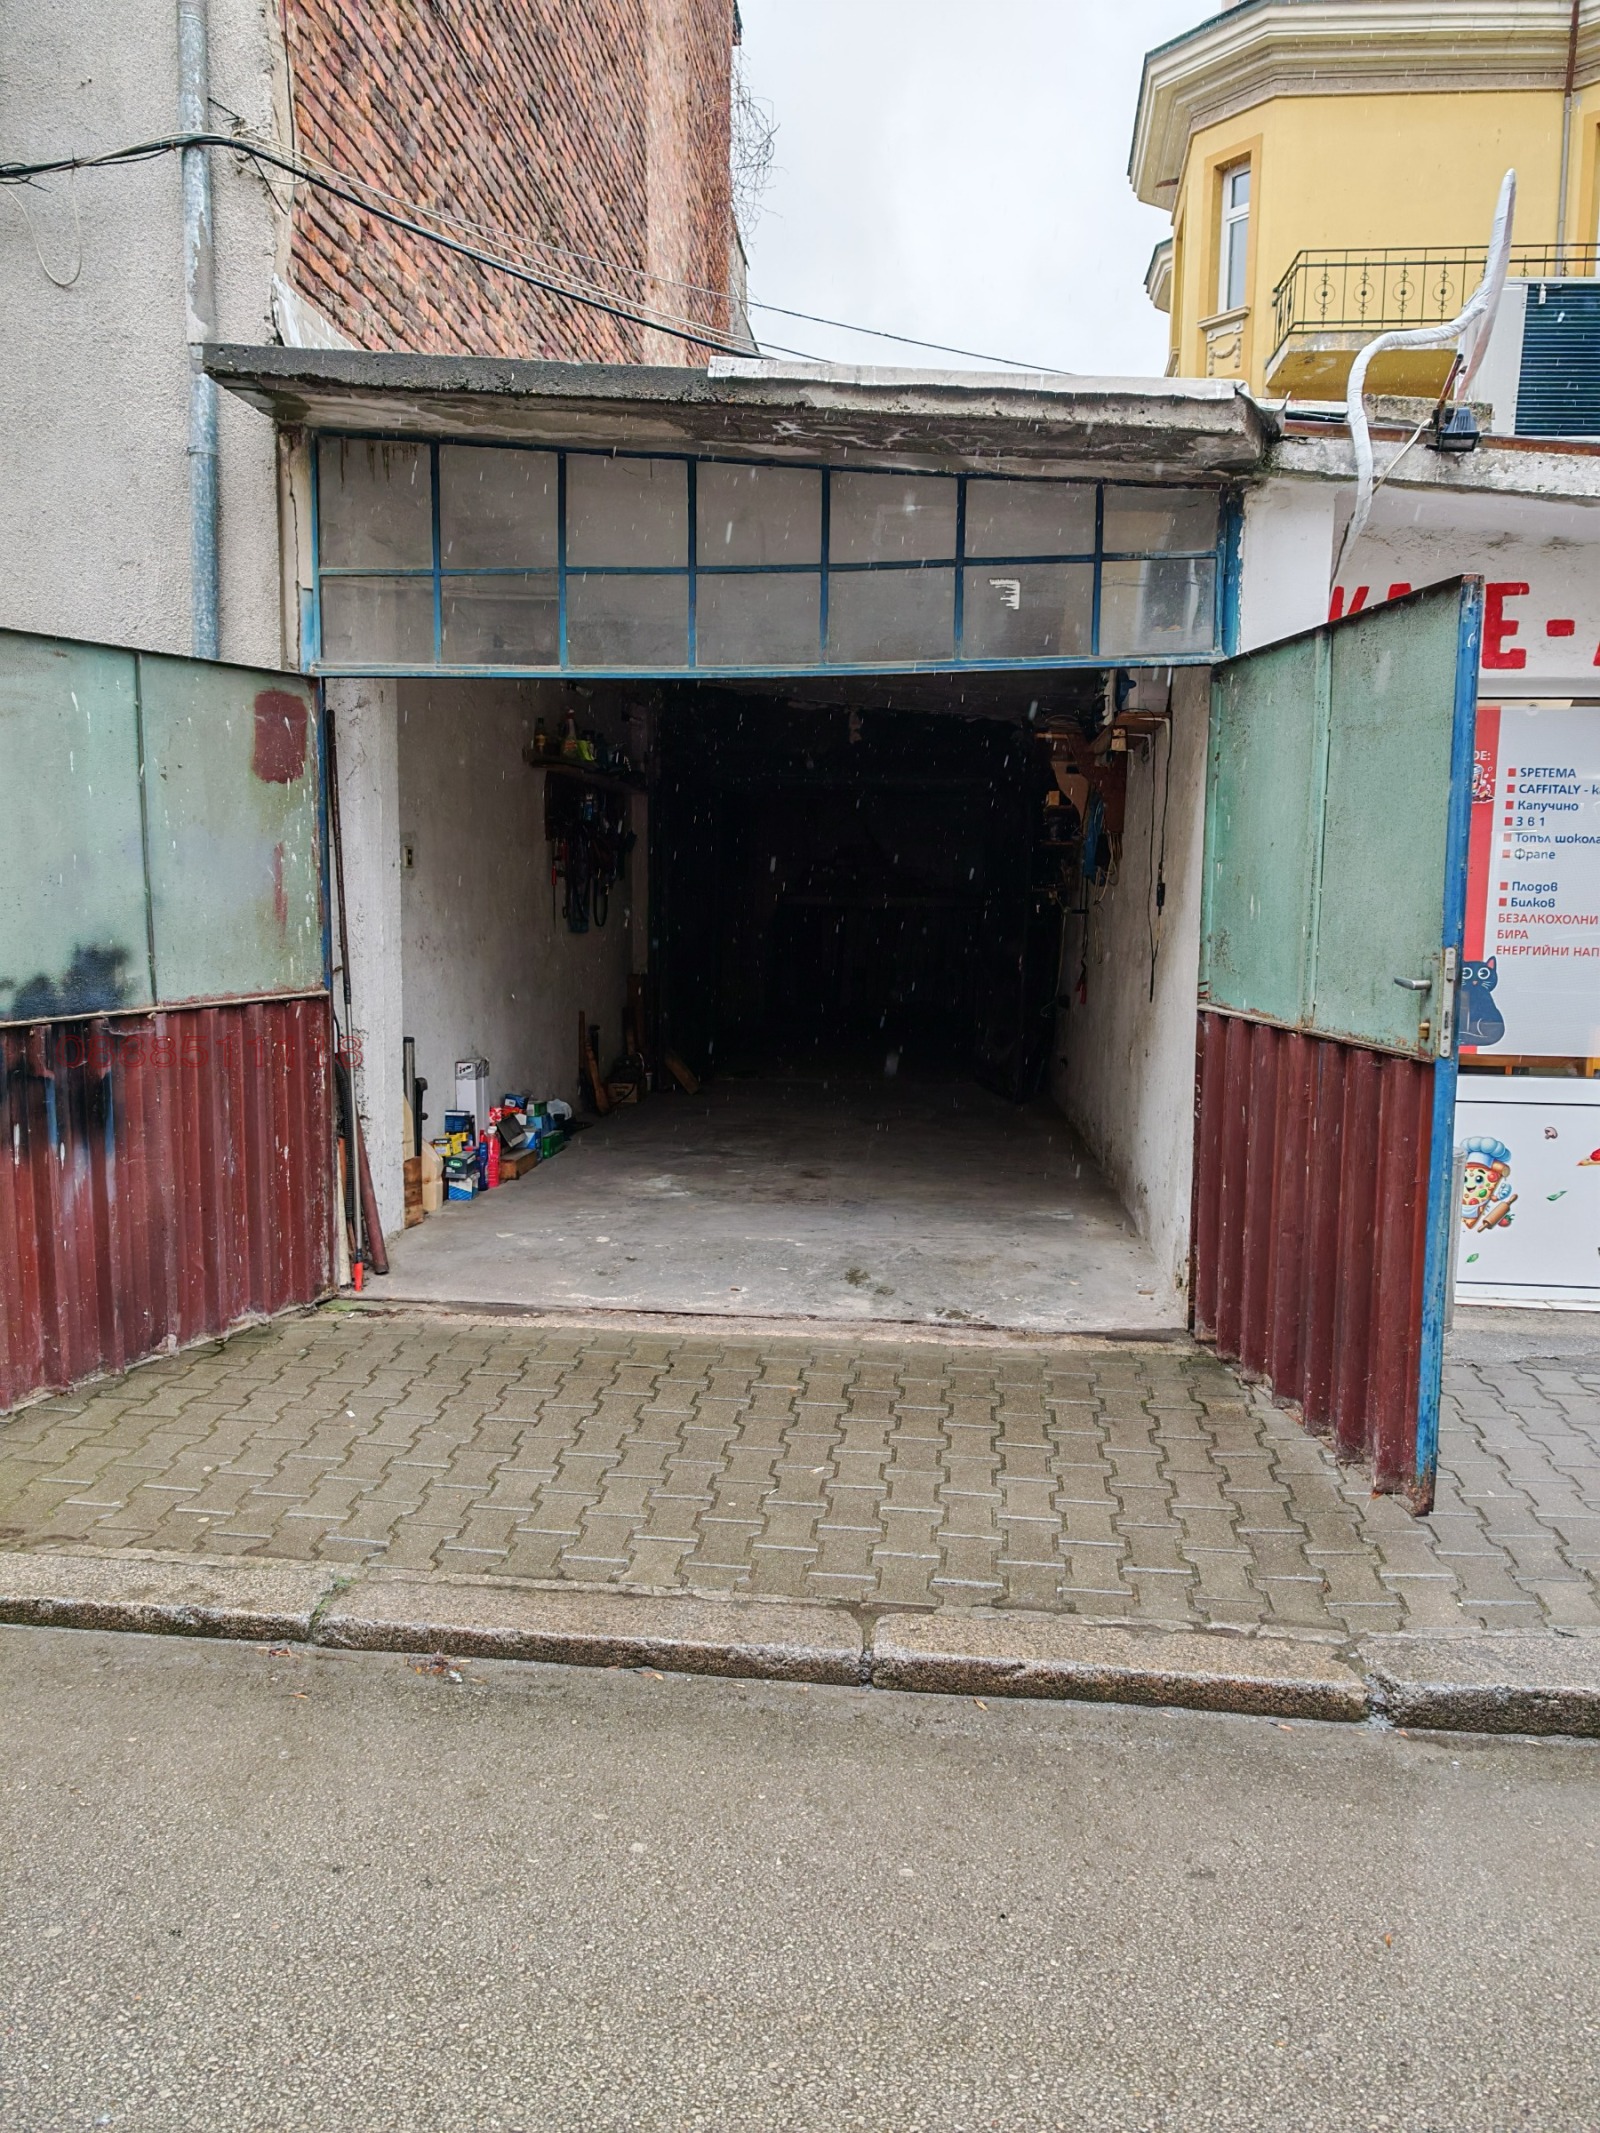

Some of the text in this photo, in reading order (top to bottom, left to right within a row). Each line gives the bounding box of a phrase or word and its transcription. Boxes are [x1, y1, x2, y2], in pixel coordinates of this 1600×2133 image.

[1520, 767, 1577, 779] SPETEMA
[1518, 783, 1581, 795] CAFFITALY
[1517, 800, 1580, 813] Капучино
[1516, 817, 1524, 827] 3
[1539, 817, 1546, 827] 1
[1516, 833, 1552, 843] Топъл
[1514, 848, 1556, 861] Фрапе
[1512, 881, 1559, 894] Плодов
[1511, 897, 1556, 908] Билков
[1498, 913, 1599, 925] БЕЗАЛКОХОЛНИ
[1497, 929, 1529, 940] БИРА
[1496, 944, 1600, 957] ЕНЕРГИЙНИ НАП
